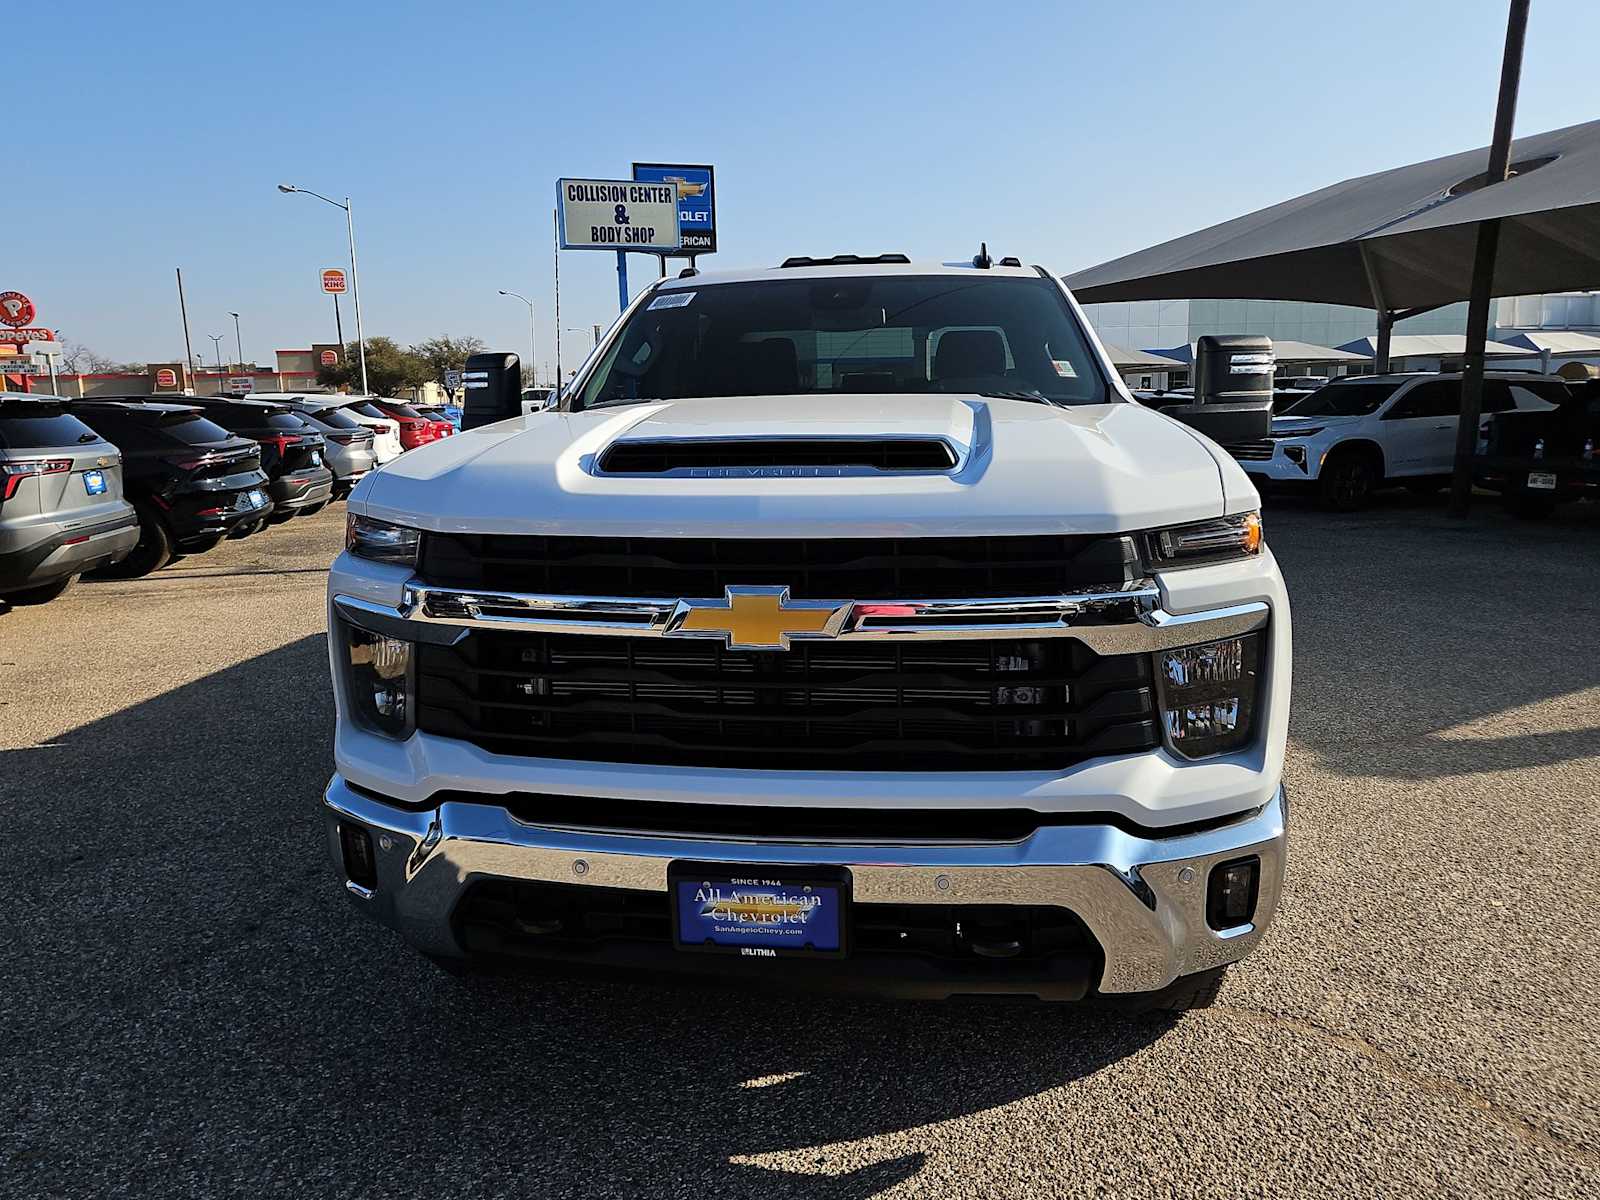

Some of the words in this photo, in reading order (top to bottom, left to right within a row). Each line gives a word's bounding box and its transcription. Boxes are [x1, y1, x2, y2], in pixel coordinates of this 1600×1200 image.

[568, 184, 628, 203] COLLISION
[630, 186, 672, 203] CENTER
[614, 204, 630, 225] &
[679, 211, 709, 222] OLET
[591, 226, 622, 243] BODY
[624, 227, 655, 244] SHOP
[730, 878, 759, 886] SINCE
[693, 887, 721, 902] All
[730, 890, 822, 906] American
[711, 906, 808, 924] Chevrolet
[714, 925, 803, 935] SanAngeloChevy.com
[749, 947, 777, 957] LITHIA
